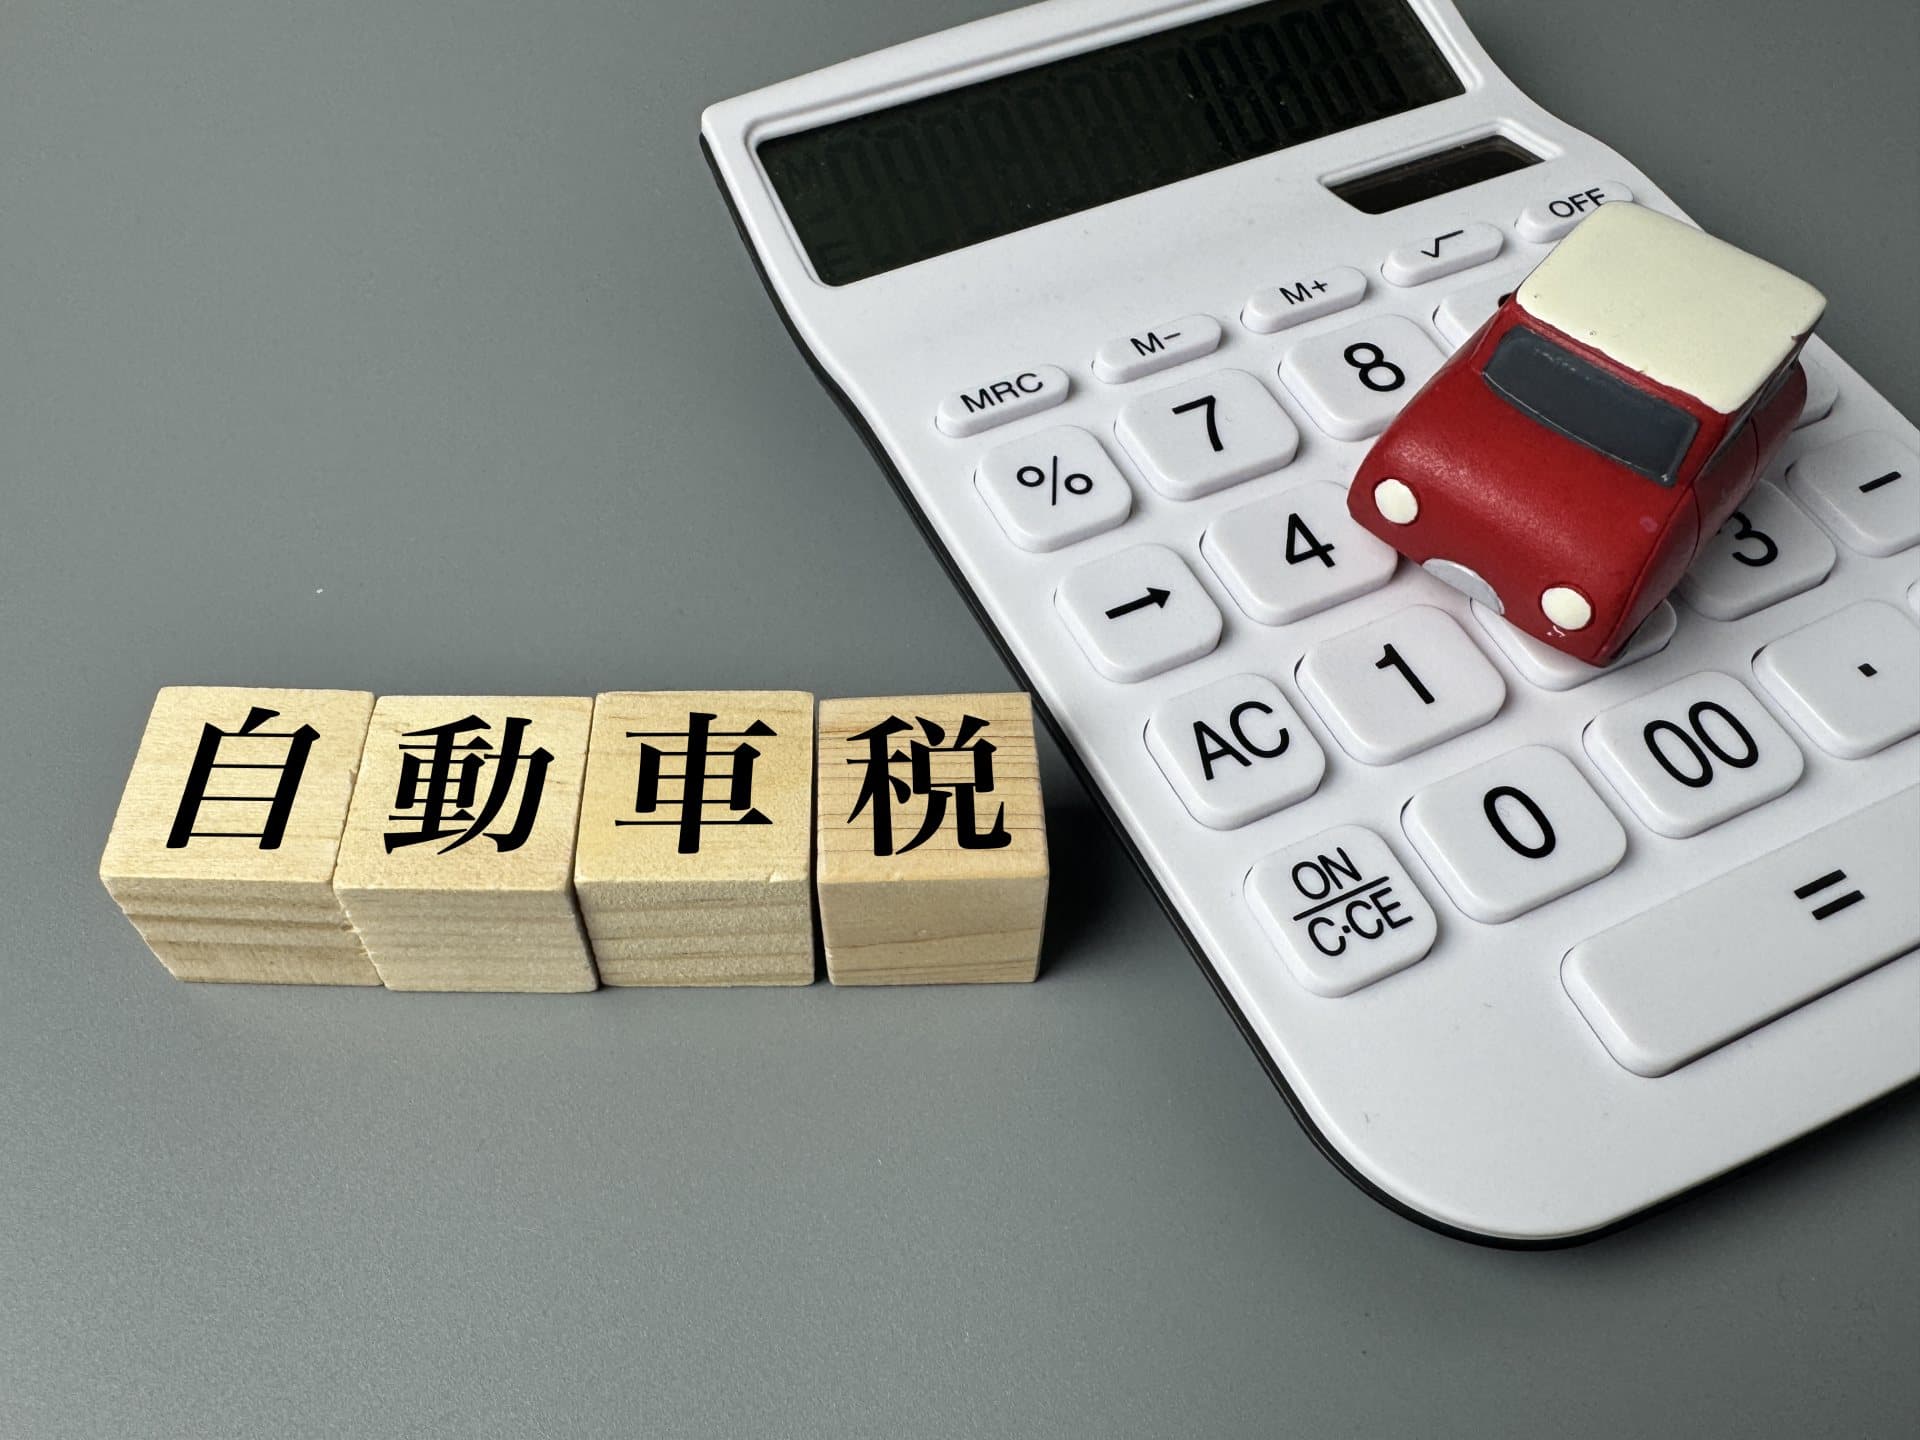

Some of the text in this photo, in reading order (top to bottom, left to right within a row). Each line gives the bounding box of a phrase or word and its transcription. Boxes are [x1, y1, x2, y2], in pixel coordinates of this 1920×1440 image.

[1548, 187, 1606, 218] OFF
[1279, 280, 1329, 305] M+
[1130, 332, 1182, 358] M-
[1343, 342, 1407, 393] 8
[960, 373, 1045, 414] MRC
[1171, 394, 1225, 453] 7
[1016, 455, 1095, 507] %
[1285, 512, 1337, 569] 4
[1717, 510, 1779, 567] 3
[1375, 643, 1436, 705] 1
[1192, 698, 1291, 781] AC
[1643, 700, 1760, 789] 00
[166, 706, 1013, 858] 自動車税
[1483, 785, 1557, 860] 0
[1291, 846, 1363, 900] ON
